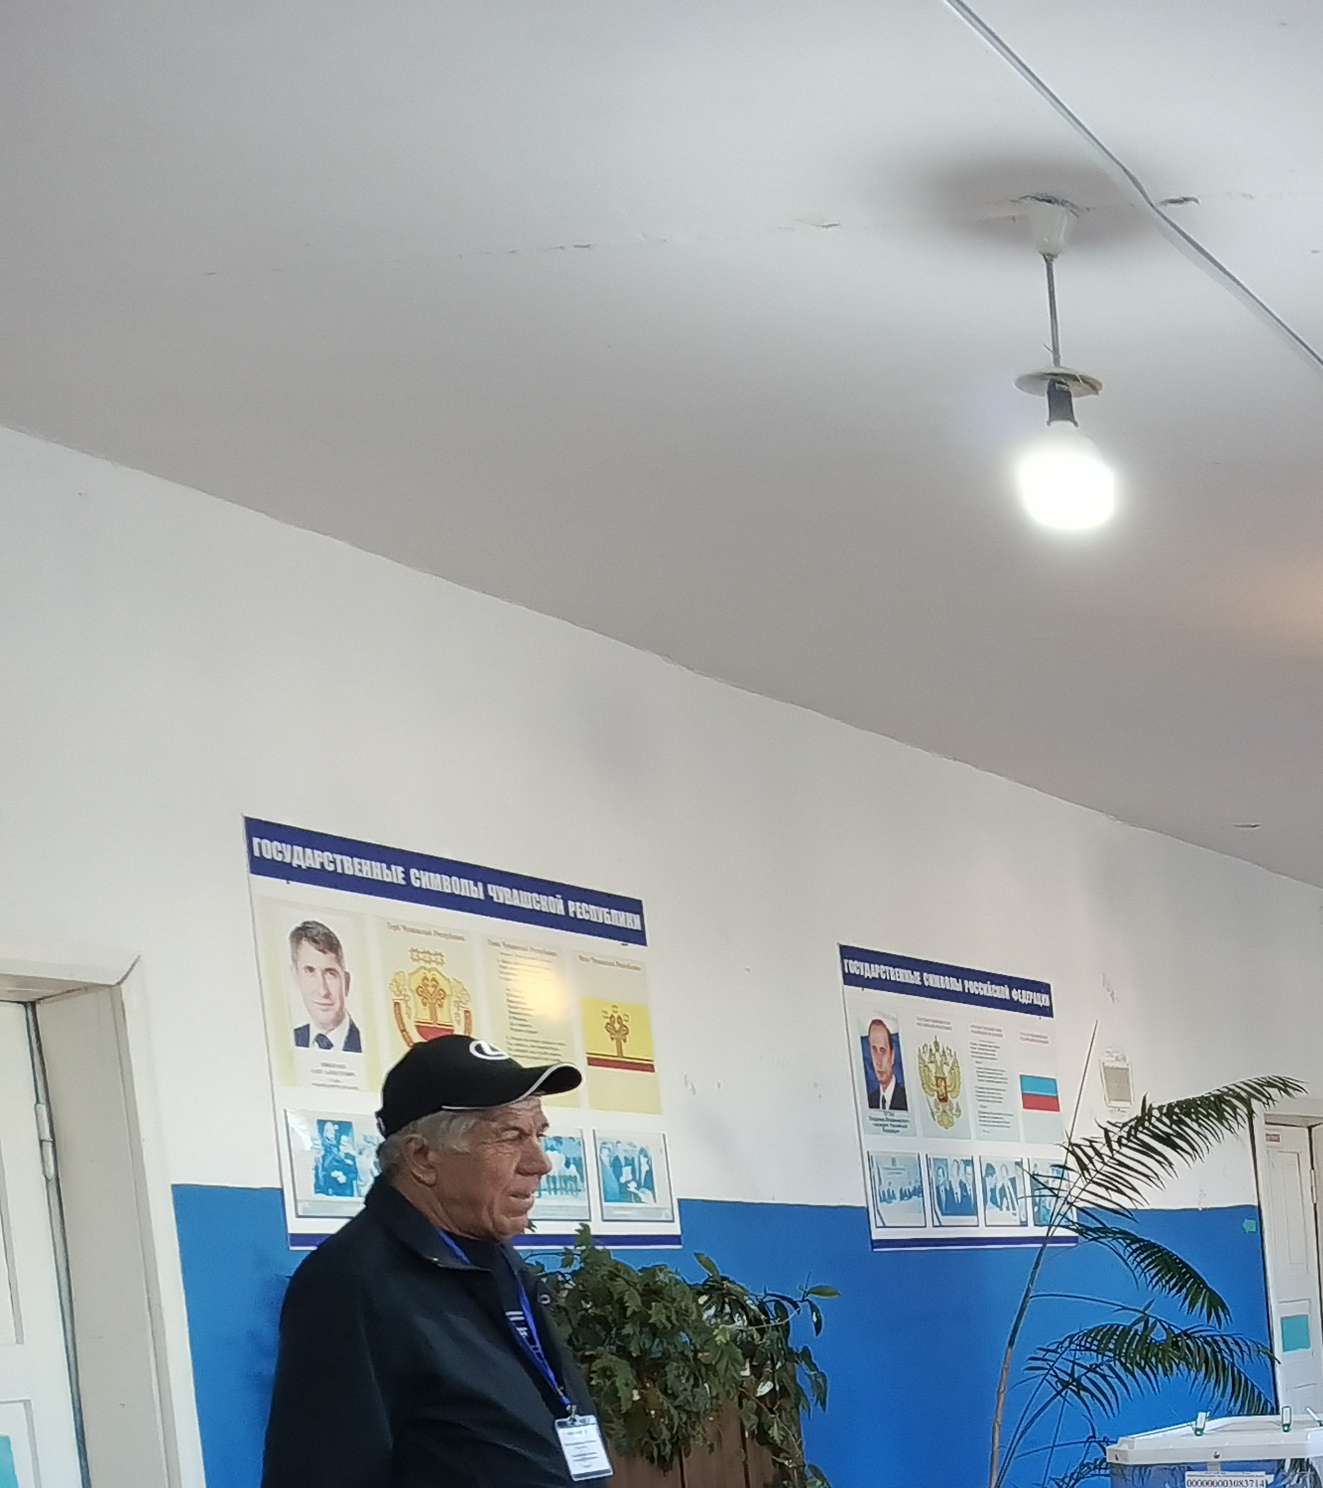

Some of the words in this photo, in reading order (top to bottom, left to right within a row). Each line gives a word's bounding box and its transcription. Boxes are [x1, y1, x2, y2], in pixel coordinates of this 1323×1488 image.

[252, 837, 406, 885] ГОСУДАРСТВЕННЫЕ
[409, 868, 485, 900] СИМВОЛЫ
[487, 883, 565, 916] ЧУВАШСКОЙ
[568, 900, 642, 931] РЕСПУБЛИКИ
[843, 959, 922, 985] ГОСУДАРСТВЕННЫЕ
[923, 972, 962, 991] СИМВОЛЫ
[964, 980, 1010, 1000] РОССИЙСКОЙ
[1011, 988, 1050, 1007] ФЕДЕРАЦИИ
